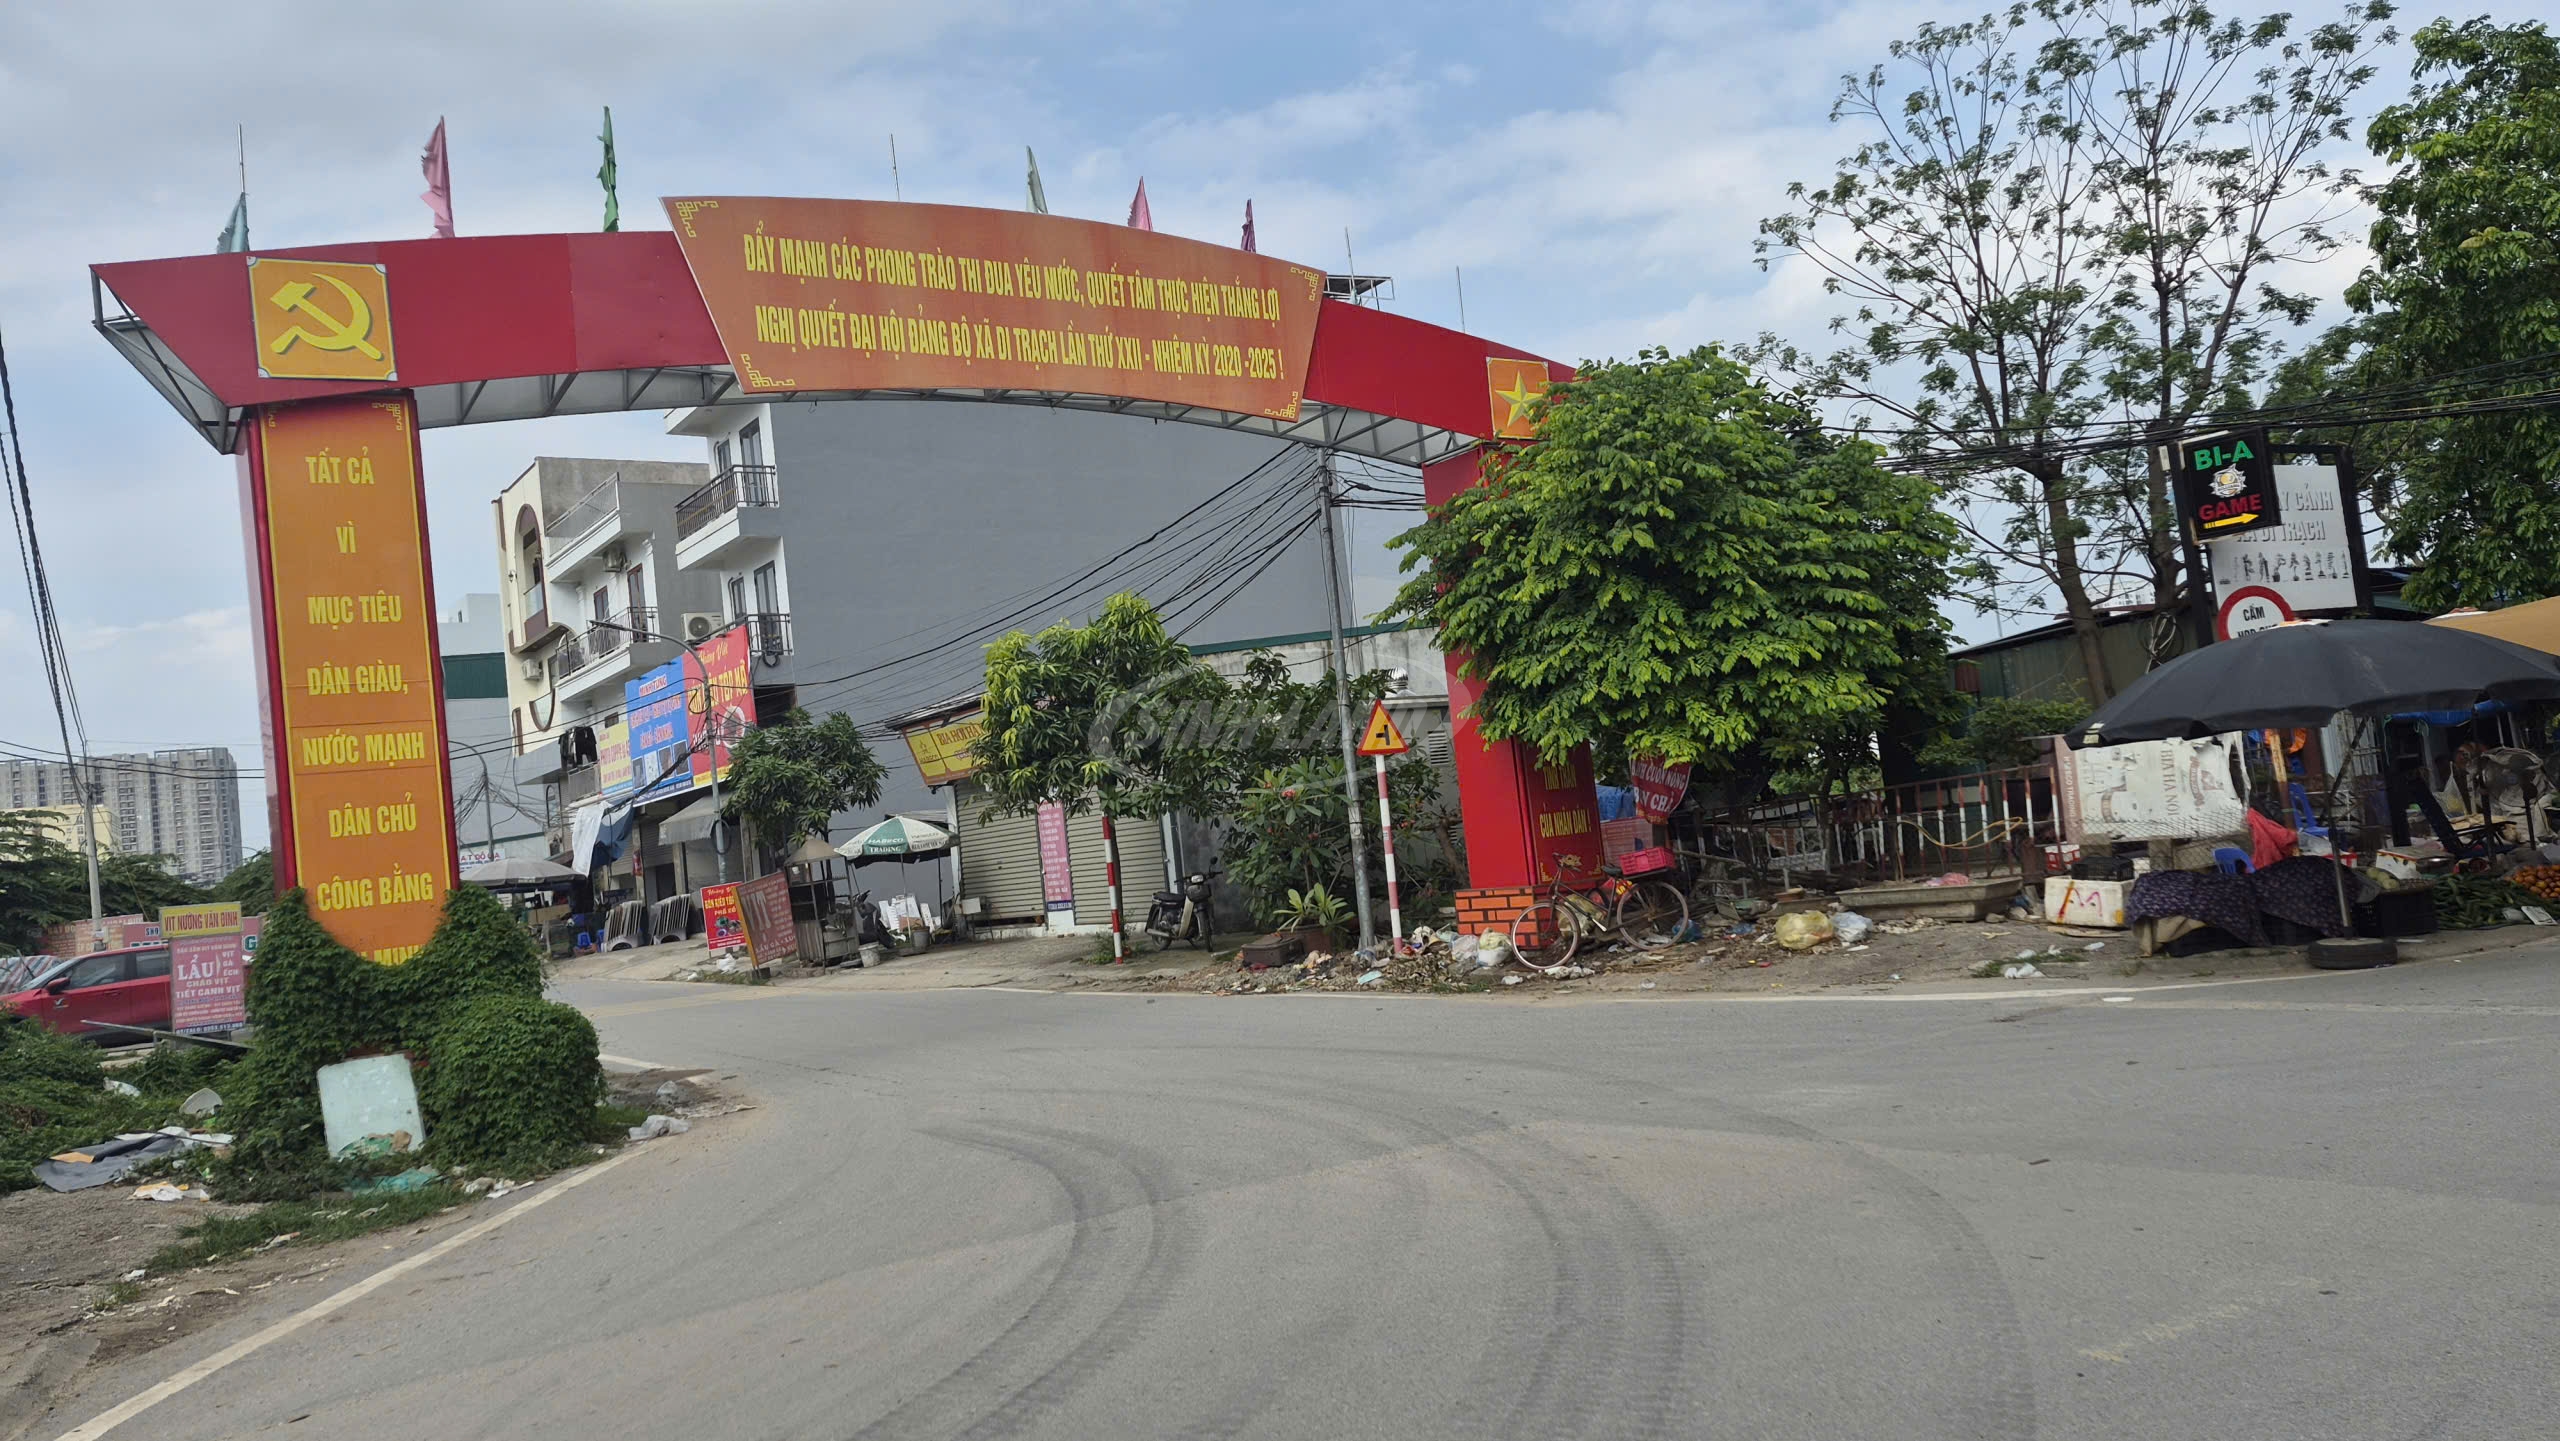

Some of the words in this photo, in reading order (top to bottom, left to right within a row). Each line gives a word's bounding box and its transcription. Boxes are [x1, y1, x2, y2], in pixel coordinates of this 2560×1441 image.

[743, 220, 775, 273] ĐẨY
[779, 237, 828, 284] MẠNH
[831, 236, 863, 282] CÁC
[864, 246, 917, 287] PHONG
[918, 247, 957, 291] TRÀO
[958, 257, 983, 293] THI
[984, 259, 1014, 296] ĐUA
[1014, 257, 1042, 299] YÊU
[1044, 257, 1084, 307] NƯỚC,
[1086, 263, 1126, 308] QUYẾT
[1127, 269, 1156, 310] TÂM
[1156, 277, 1189, 319] THỰC
[1191, 276, 1221, 322] HIỆN
[1221, 275, 1260, 320] THẮNG
[1261, 287, 1281, 327] LỢI
[755, 304, 796, 353] NGHỊ
[799, 298, 846, 350] QUYẾT
[849, 313, 877, 358] ĐẠI
[879, 308, 906, 361] HỘI
[907, 303, 949, 356] ĐẢNG
[951, 315, 972, 366] BỘ
[973, 317, 995, 360] XÃ
[996, 325, 1012, 361] DI
[1013, 327, 1058, 371] TRẠCH
[1060, 319, 1087, 366] LẦN
[1088, 325, 1113, 369] THỨ
[1115, 336, 1143, 371] XXII
[1152, 334, 1194, 381] NHIỆM
[1195, 336, 1211, 375] KỲ
[1213, 345, 1242, 377] 2020
[306, 446, 341, 484] TẤT
[346, 446, 375, 485] CẢ
[2194, 440, 2255, 471] BI-A
[2199, 493, 2263, 521] GAME
[336, 523, 356, 554] VÌ
[308, 595, 354, 630] MỤC
[359, 592, 402, 623] TIÊU
[307, 663, 351, 695] DÂN
[355, 659, 409, 695] GIÀU,
[303, 732, 360, 766] NƯỚC
[365, 731, 425, 767] MẠNH
[328, 803, 372, 838] DÂN
[377, 791, 417, 832] CHỦ
[870, 845, 901, 854] TRADING
[317, 874, 373, 912] CÔNG
[378, 862, 434, 906] BẰNG
[178, 954, 214, 980] LẨU
